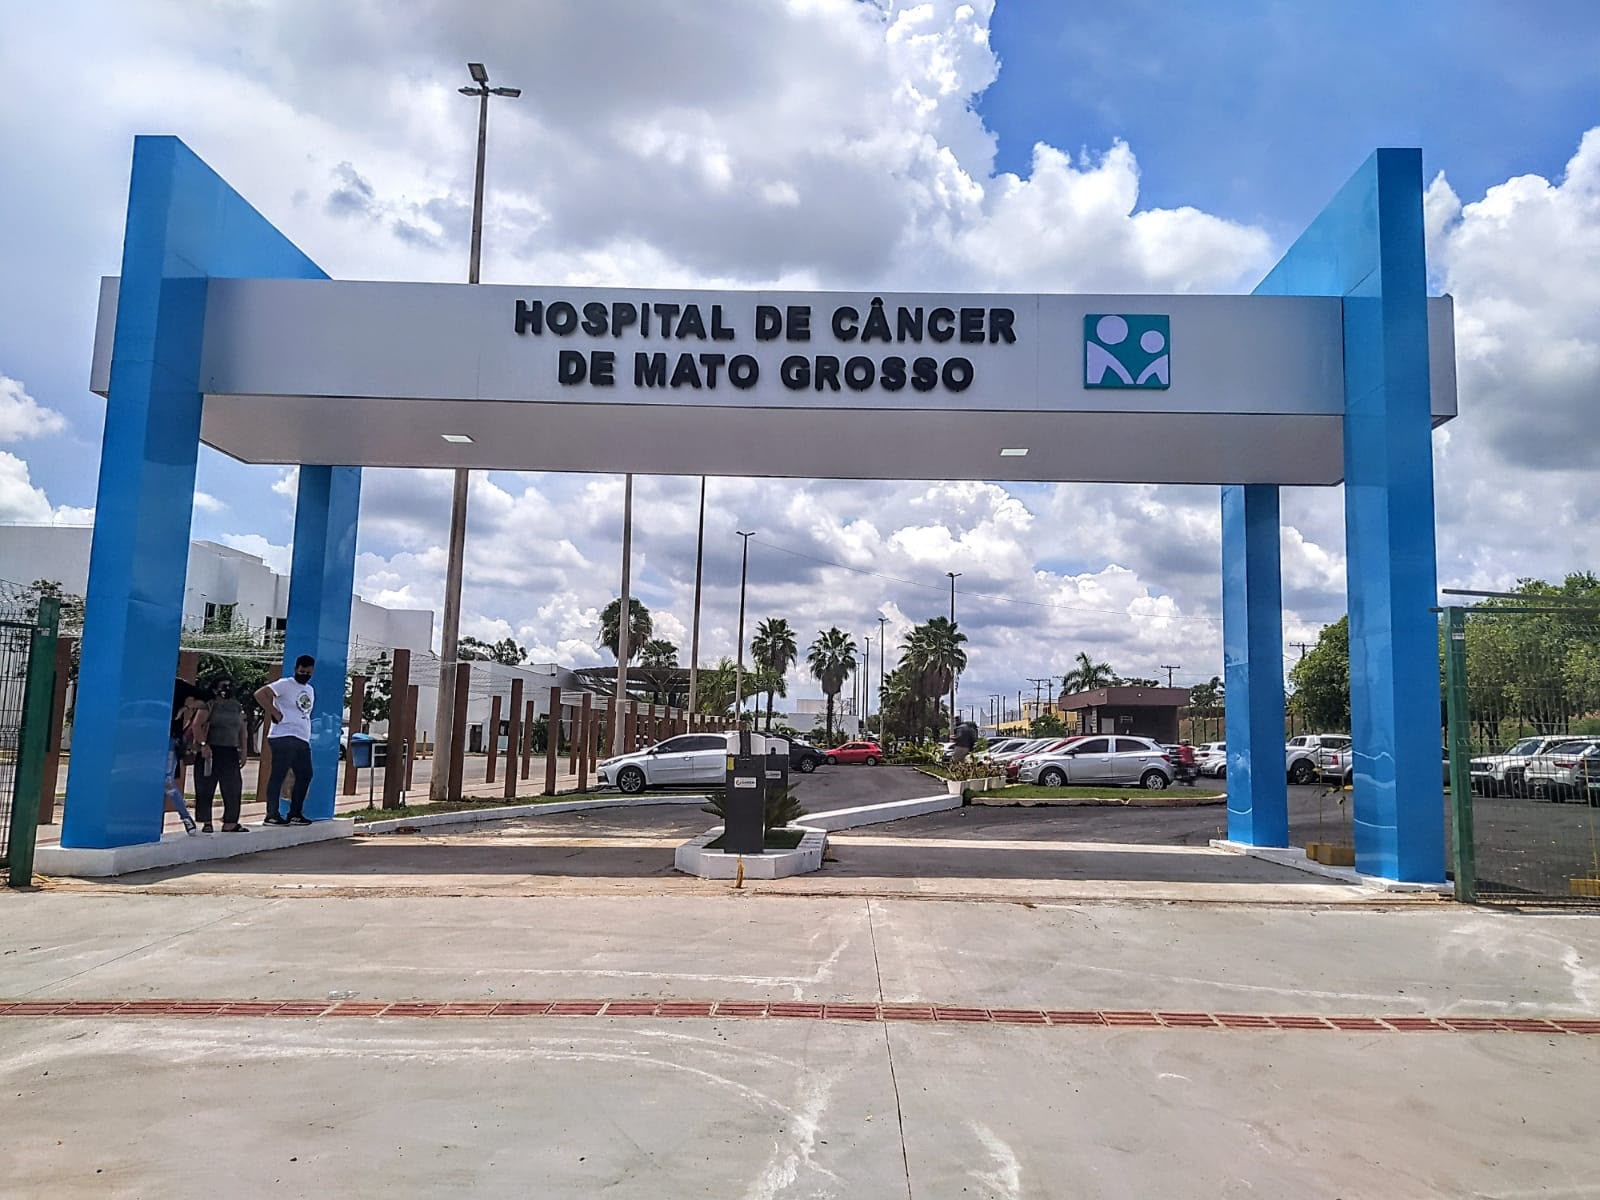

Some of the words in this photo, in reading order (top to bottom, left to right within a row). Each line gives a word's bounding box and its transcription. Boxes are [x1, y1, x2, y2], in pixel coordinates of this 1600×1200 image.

[514, 299, 736, 342] HOSPITAL
[755, 305, 812, 343] DE
[831, 296, 1017, 345] CÂNCER
[557, 350, 616, 388] DE
[633, 351, 760, 391] MATO
[780, 355, 975, 394] GROSSO
